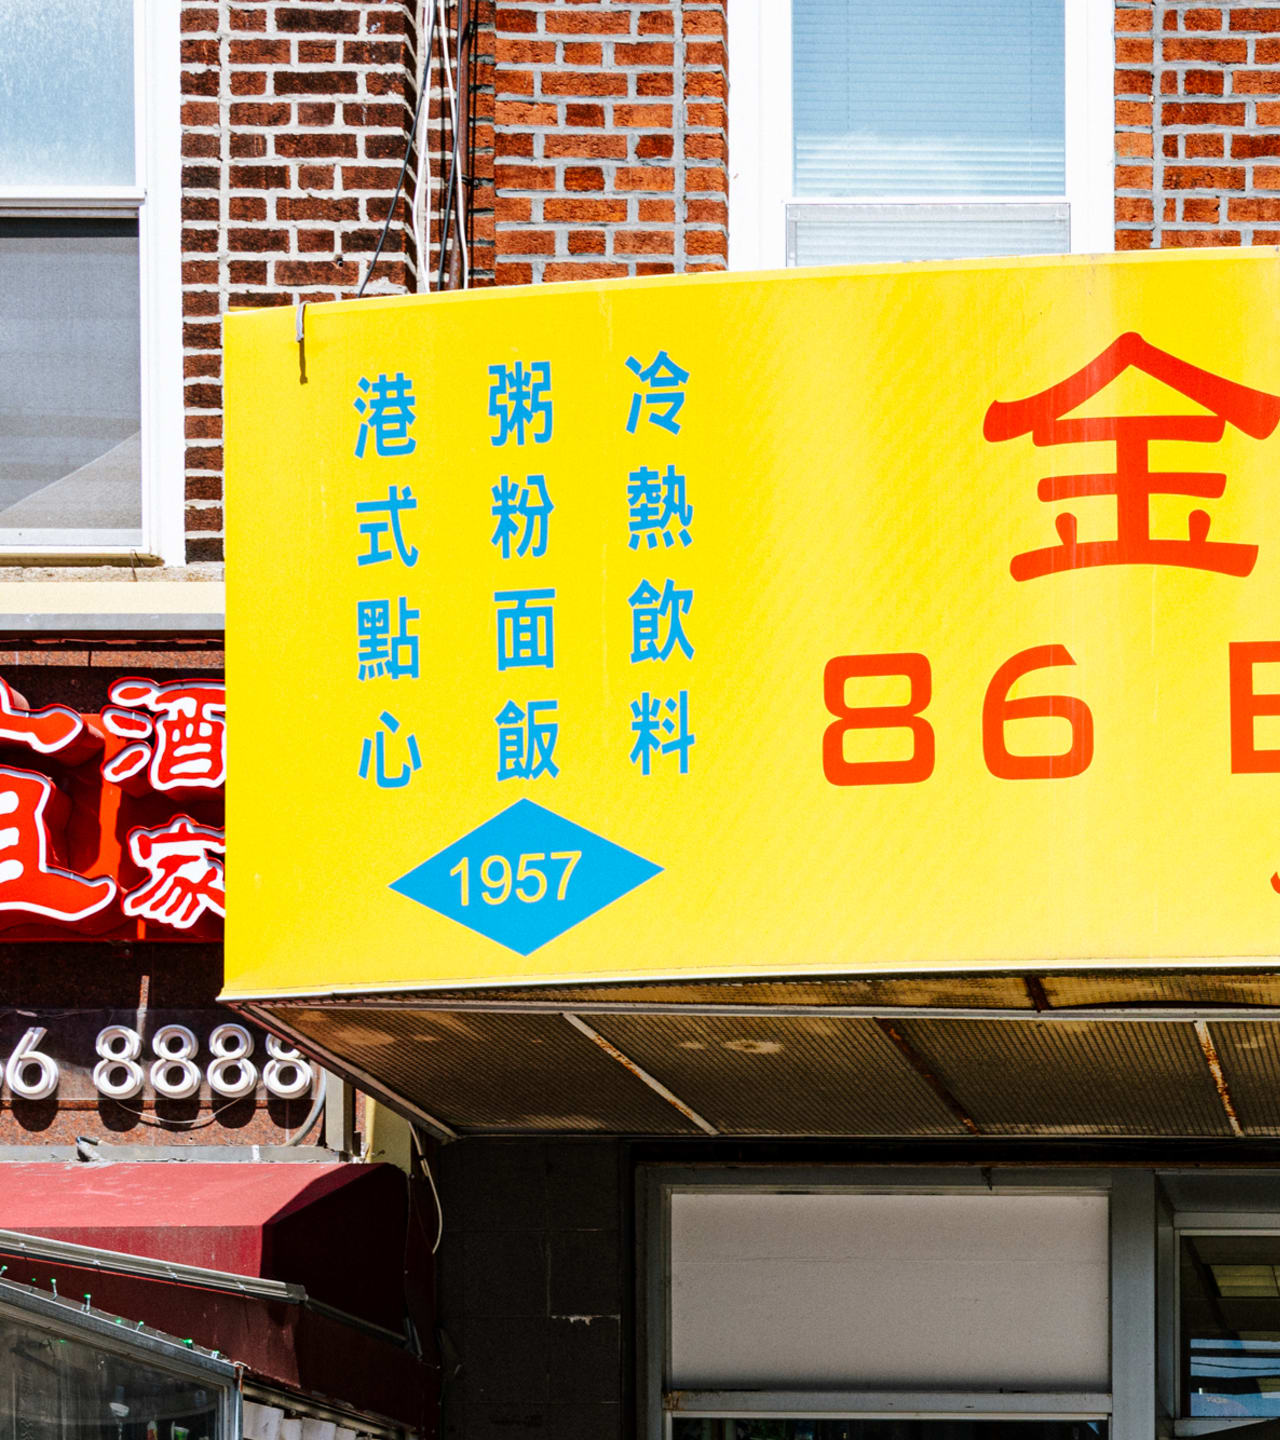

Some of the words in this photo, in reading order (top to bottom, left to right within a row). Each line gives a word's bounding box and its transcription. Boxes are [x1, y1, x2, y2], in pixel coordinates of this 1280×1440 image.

[353, 372, 423, 789] 港式點心
[487, 360, 560, 782] 粥粉面飯
[624, 350, 696, 777] 冷熱飲料
[821, 643, 1095, 787] 86
[448, 850, 583, 907] 1957
[92, 1022, 314, 1100] 8888
